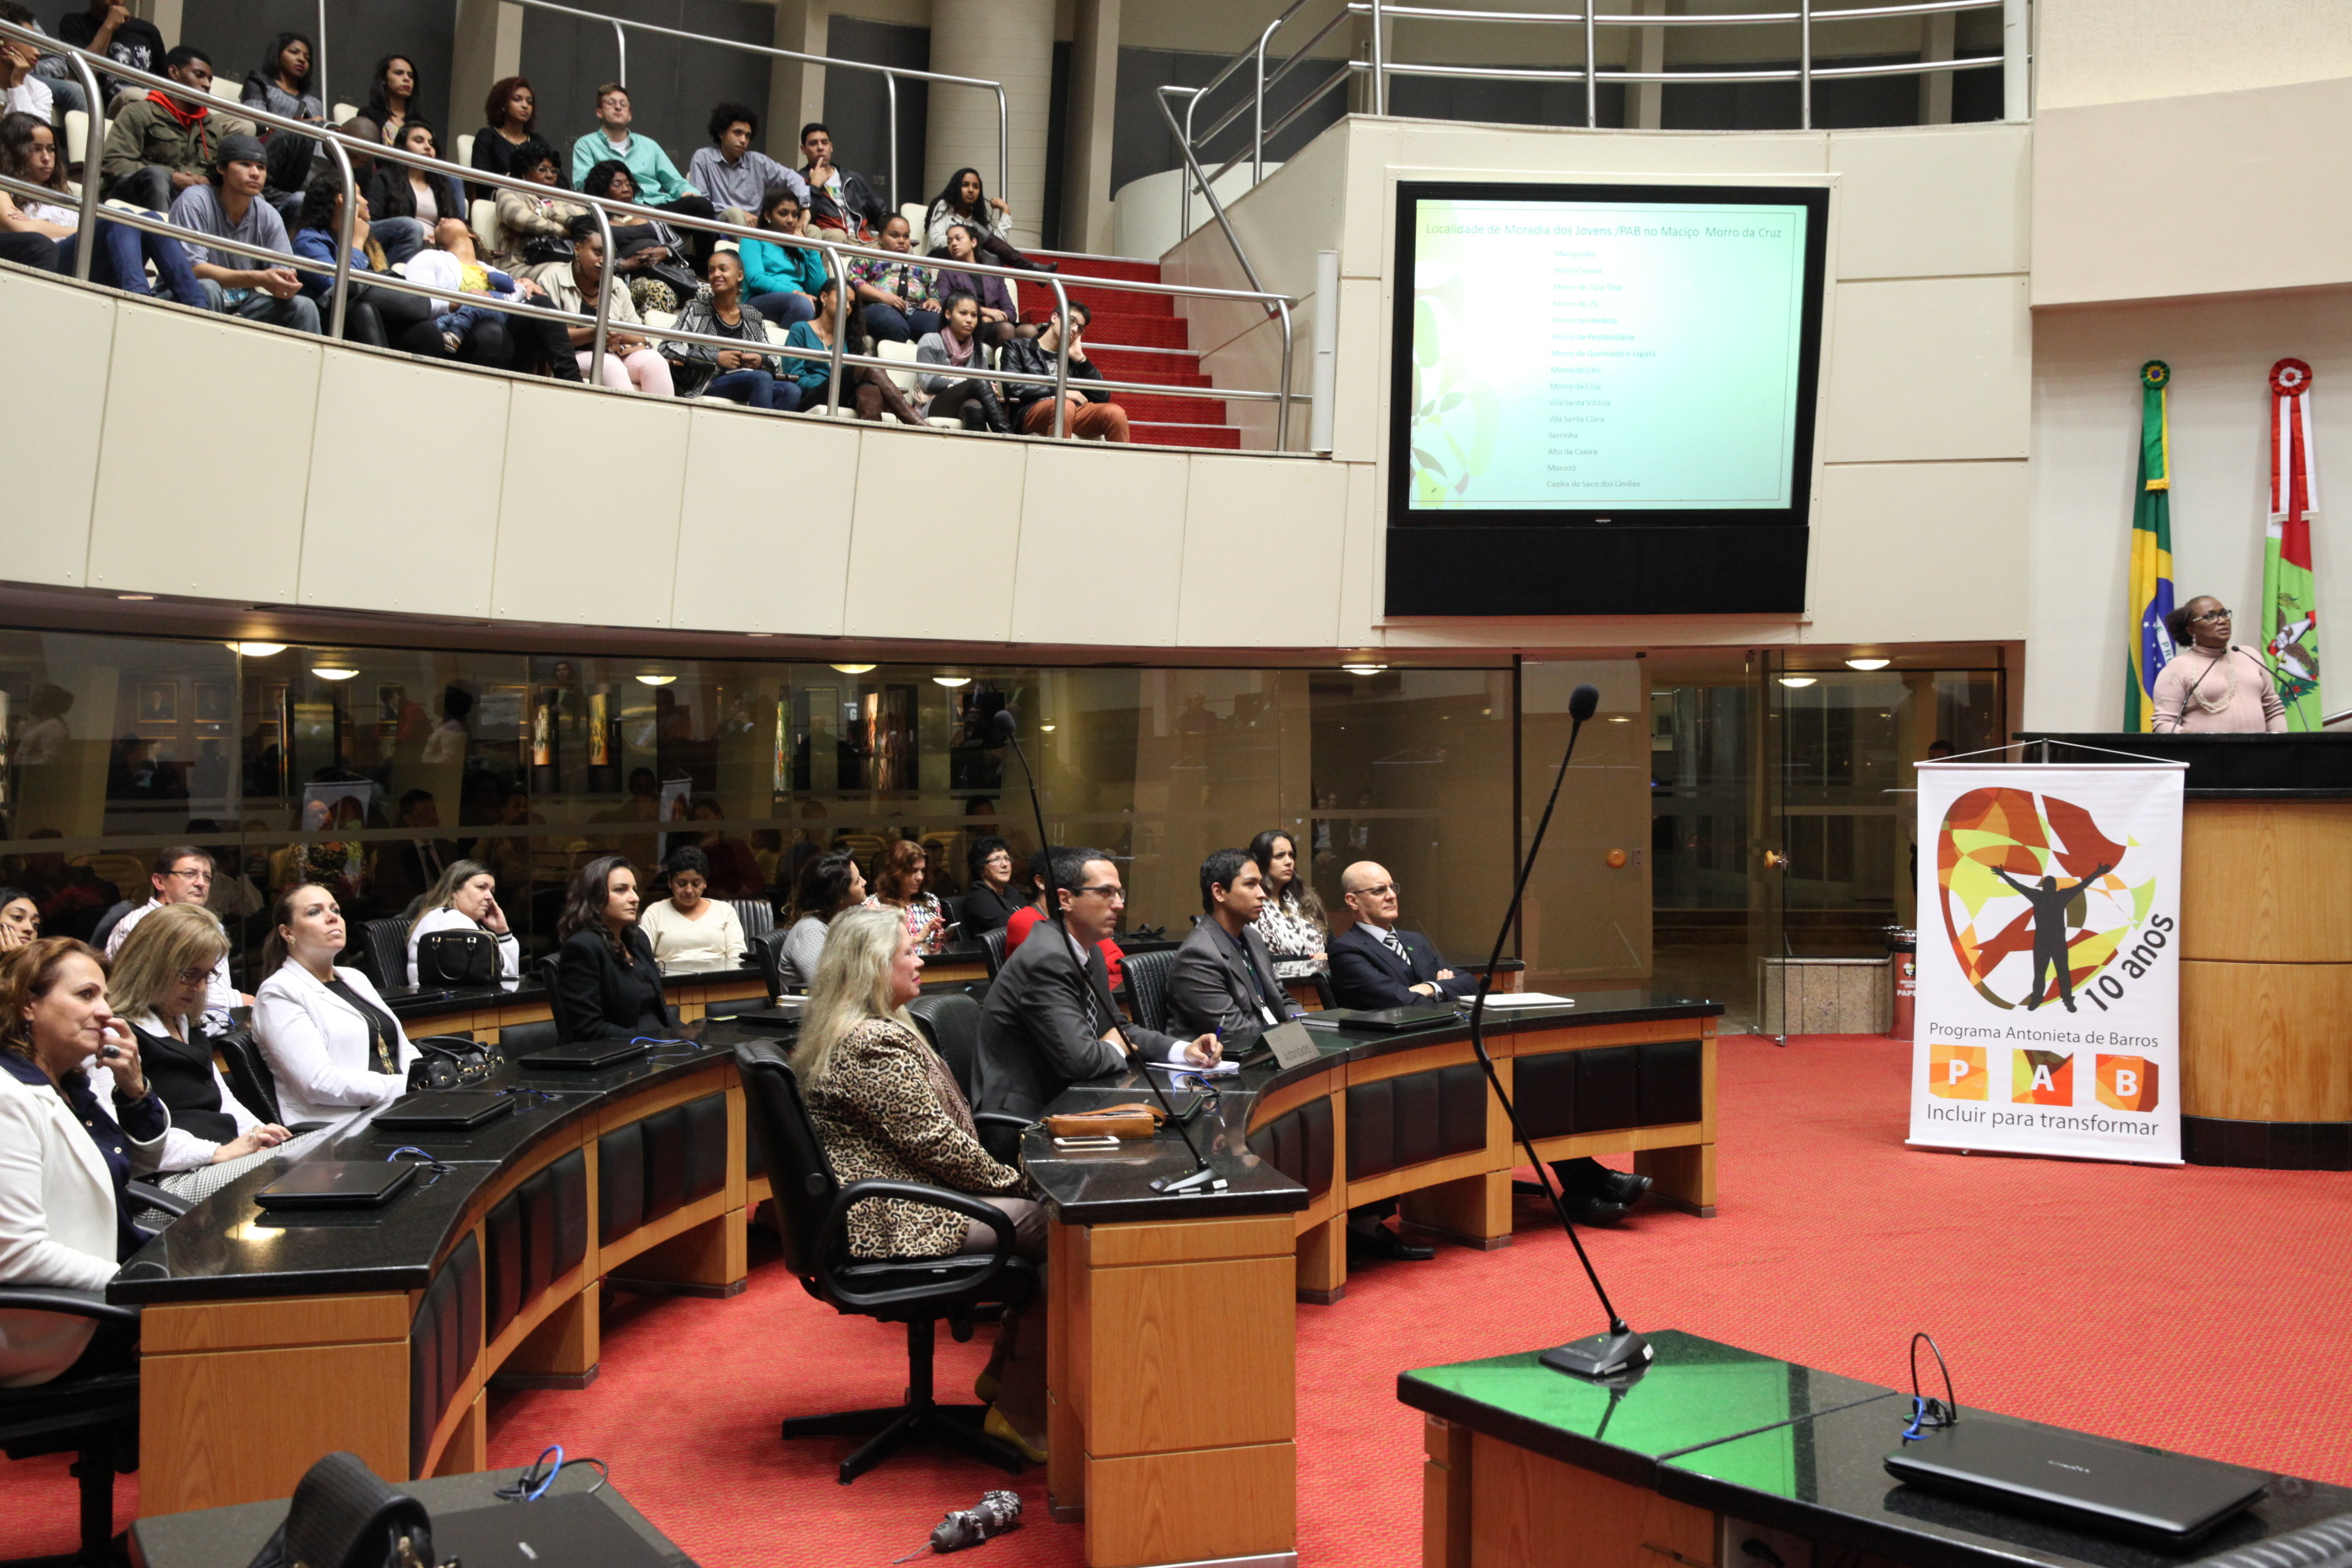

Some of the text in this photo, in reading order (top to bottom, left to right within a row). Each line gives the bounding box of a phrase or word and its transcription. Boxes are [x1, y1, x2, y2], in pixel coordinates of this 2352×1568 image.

[1426, 223, 1782, 239] Localidade de Moradia dos Jovens /PAB no Maciço Morro da Cruz
[1553, 283, 1623, 291] Morro do Tico Tico
[1551, 333, 1576, 341] Morro
[1551, 349, 1575, 358] Morro
[1587, 349, 1624, 358] Queimada
[2085, 913, 2175, 1012] 10 anos
[1930, 1021, 2159, 1048] Programa Antonieta de Barros
[1927, 1103, 2159, 1136] Incluir para transformar
